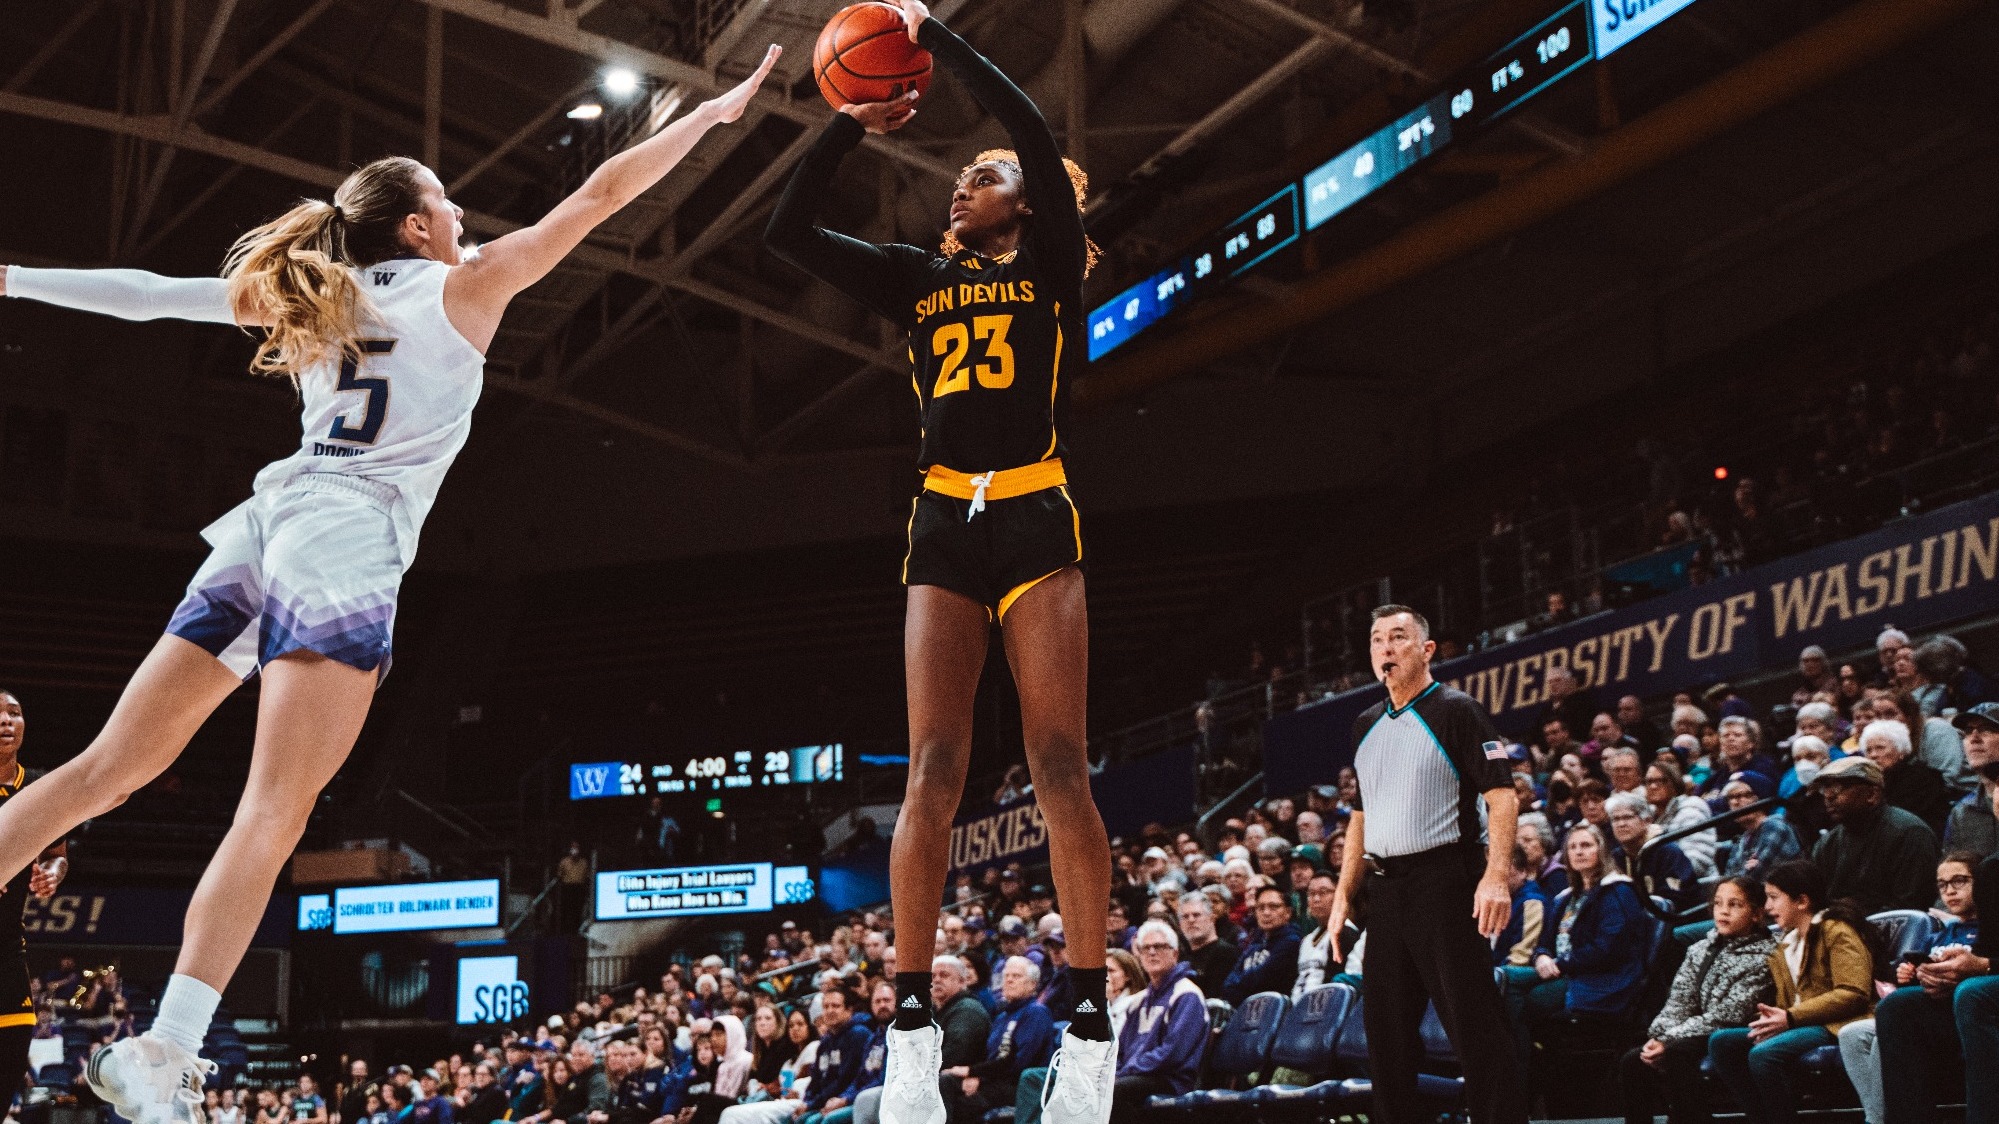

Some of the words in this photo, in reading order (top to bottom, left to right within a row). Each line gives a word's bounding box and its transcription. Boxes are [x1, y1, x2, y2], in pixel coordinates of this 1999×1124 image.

[1537, 27, 1570, 64] 100
[373, 271, 396, 286] W
[915, 287, 953, 323] SUN
[960, 280, 1035, 307] DEVILS
[933, 314, 1015, 398] 23
[327, 337, 399, 446] 5
[1688, 591, 1756, 660] OF
[1770, 517, 1999, 638] WASHIN
[575, 766, 609, 796] W
[619, 763, 643, 783] 24
[684, 757, 726, 778] 4:00
[764, 751, 789, 772] 29
[646, 874, 680, 892] Injury
[681, 871, 708, 888] Trial
[709, 871, 754, 889] Lawyers
[474, 980, 529, 1023] SGB
